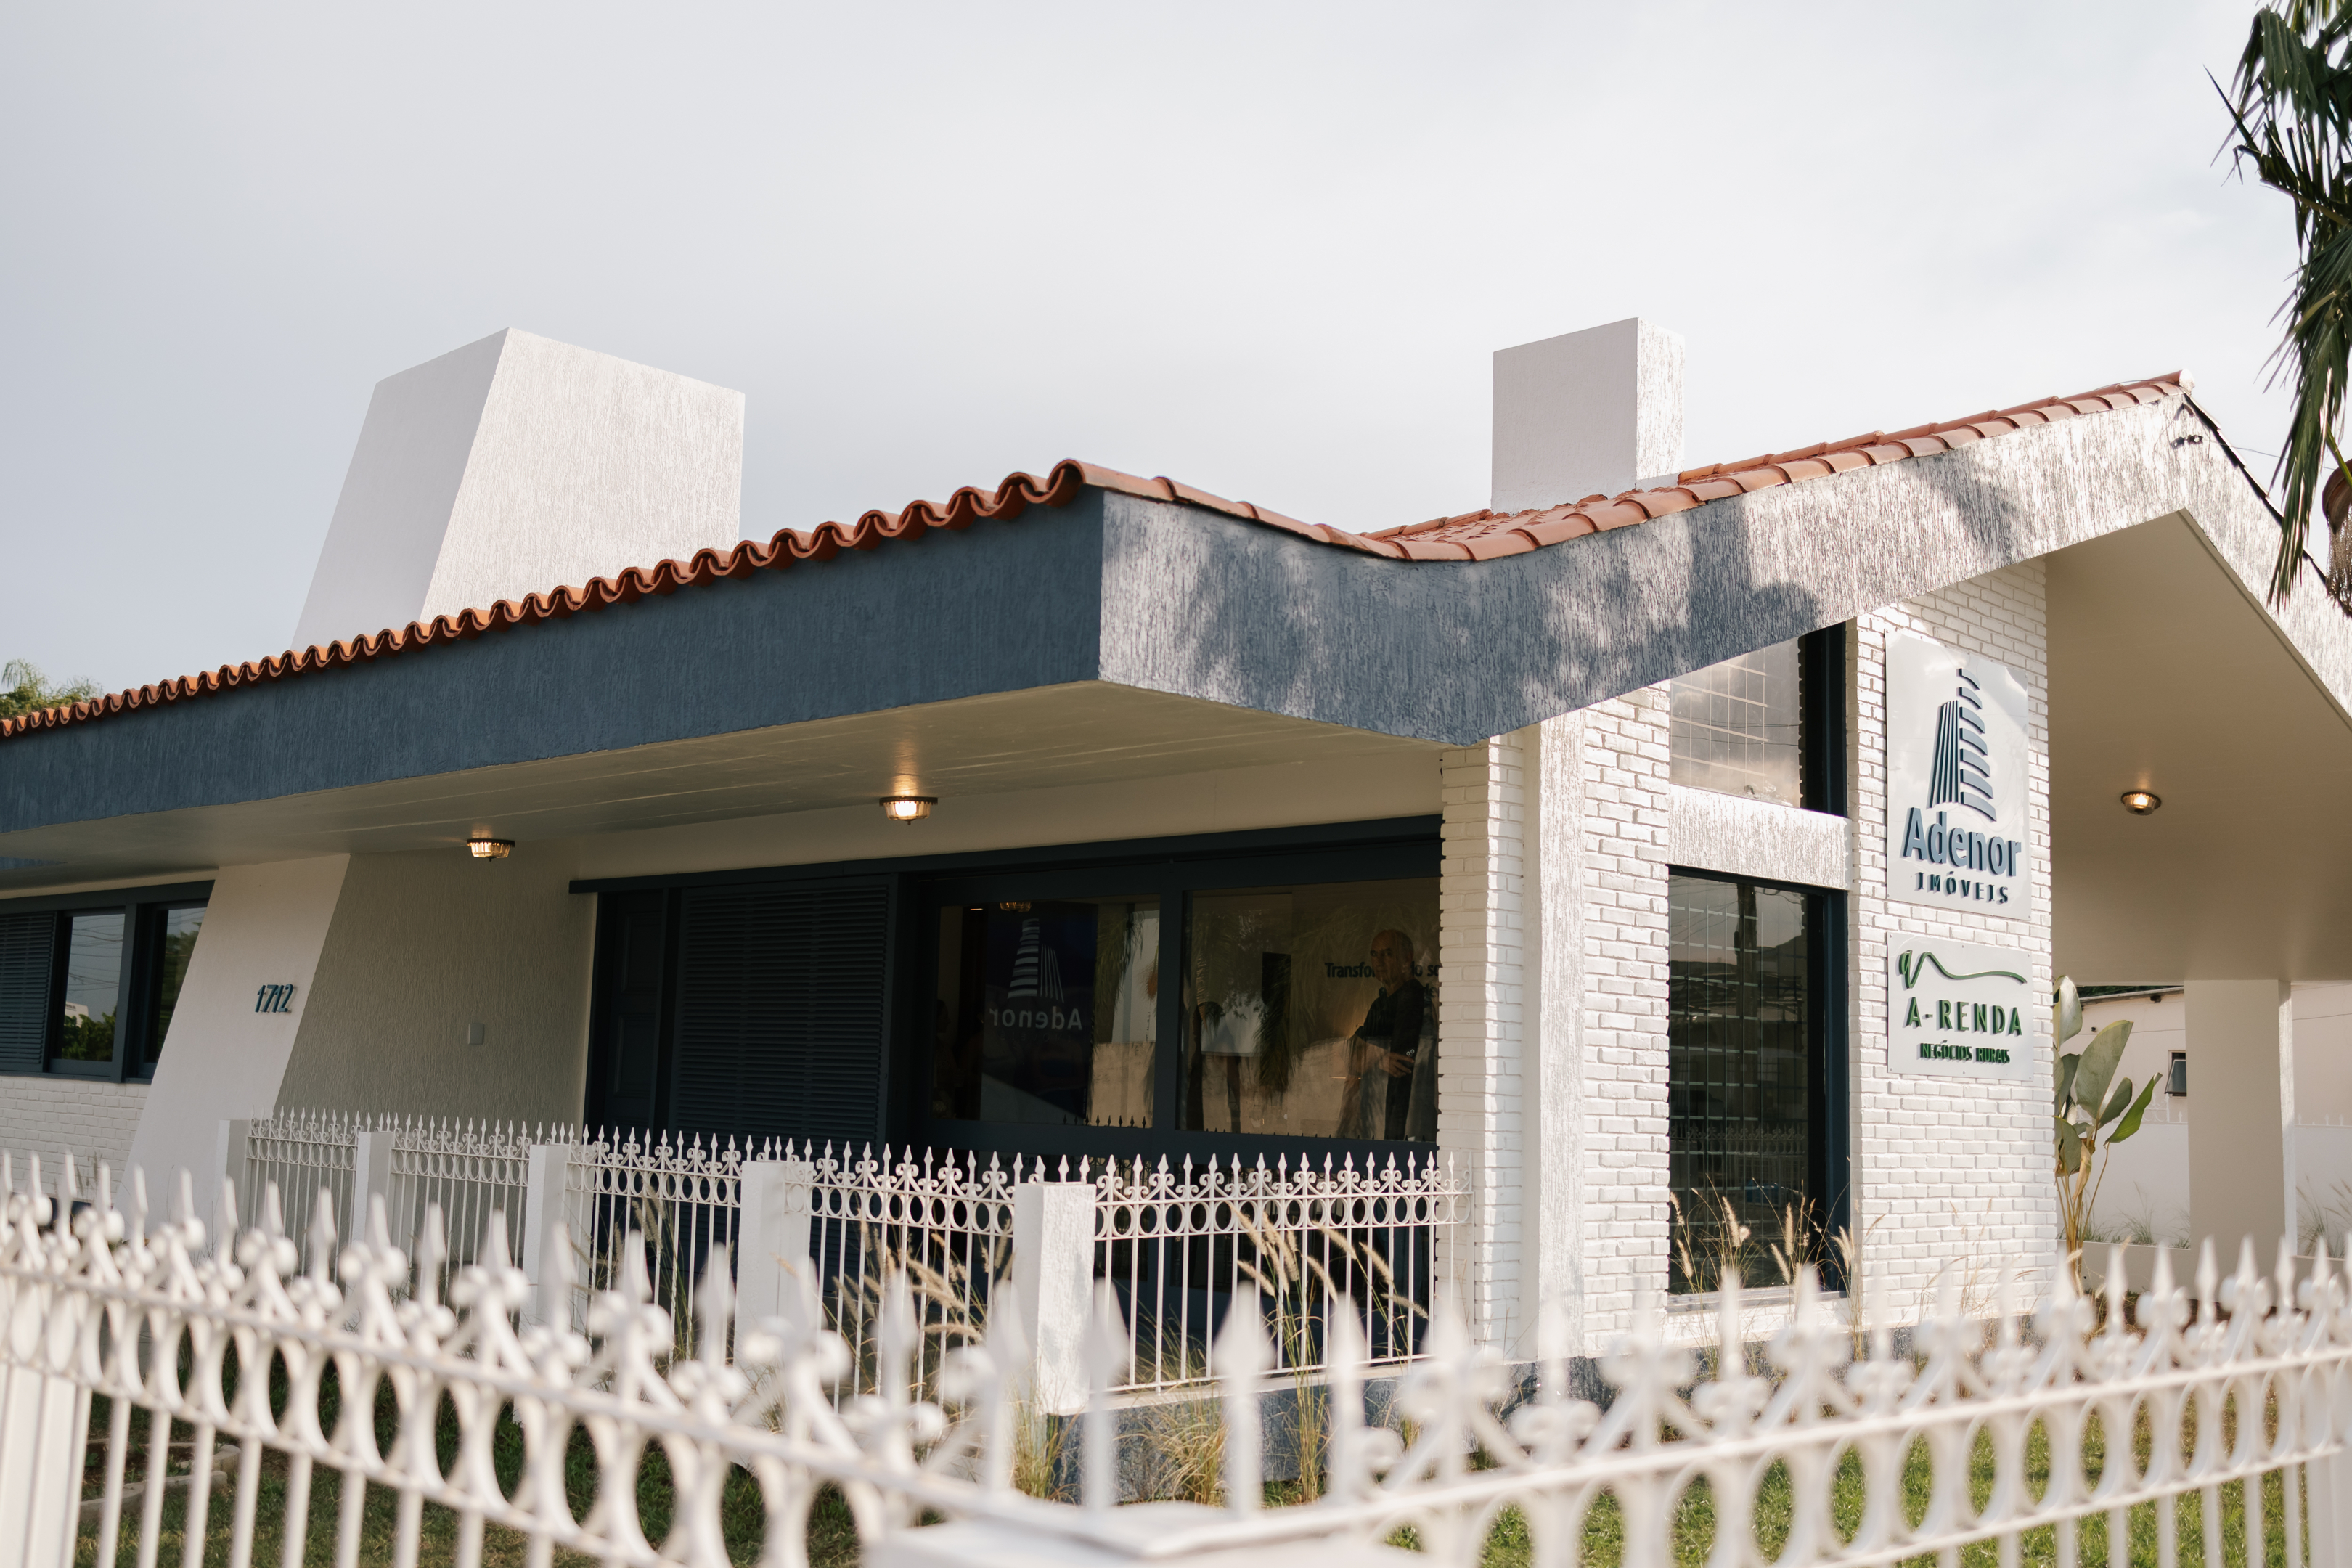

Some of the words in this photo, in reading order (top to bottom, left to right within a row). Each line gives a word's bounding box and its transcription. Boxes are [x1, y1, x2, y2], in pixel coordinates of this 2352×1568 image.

[1903, 807, 2022, 876] Adenor
[1917, 870, 2009, 904] IMÓVEIS
[255, 983, 294, 1013] 1712
[1906, 996, 2022, 1036] A-RENDA
[1919, 1040, 1973, 1061] NEGÓCIOS
[1975, 1047, 2011, 1064] RURAIS
